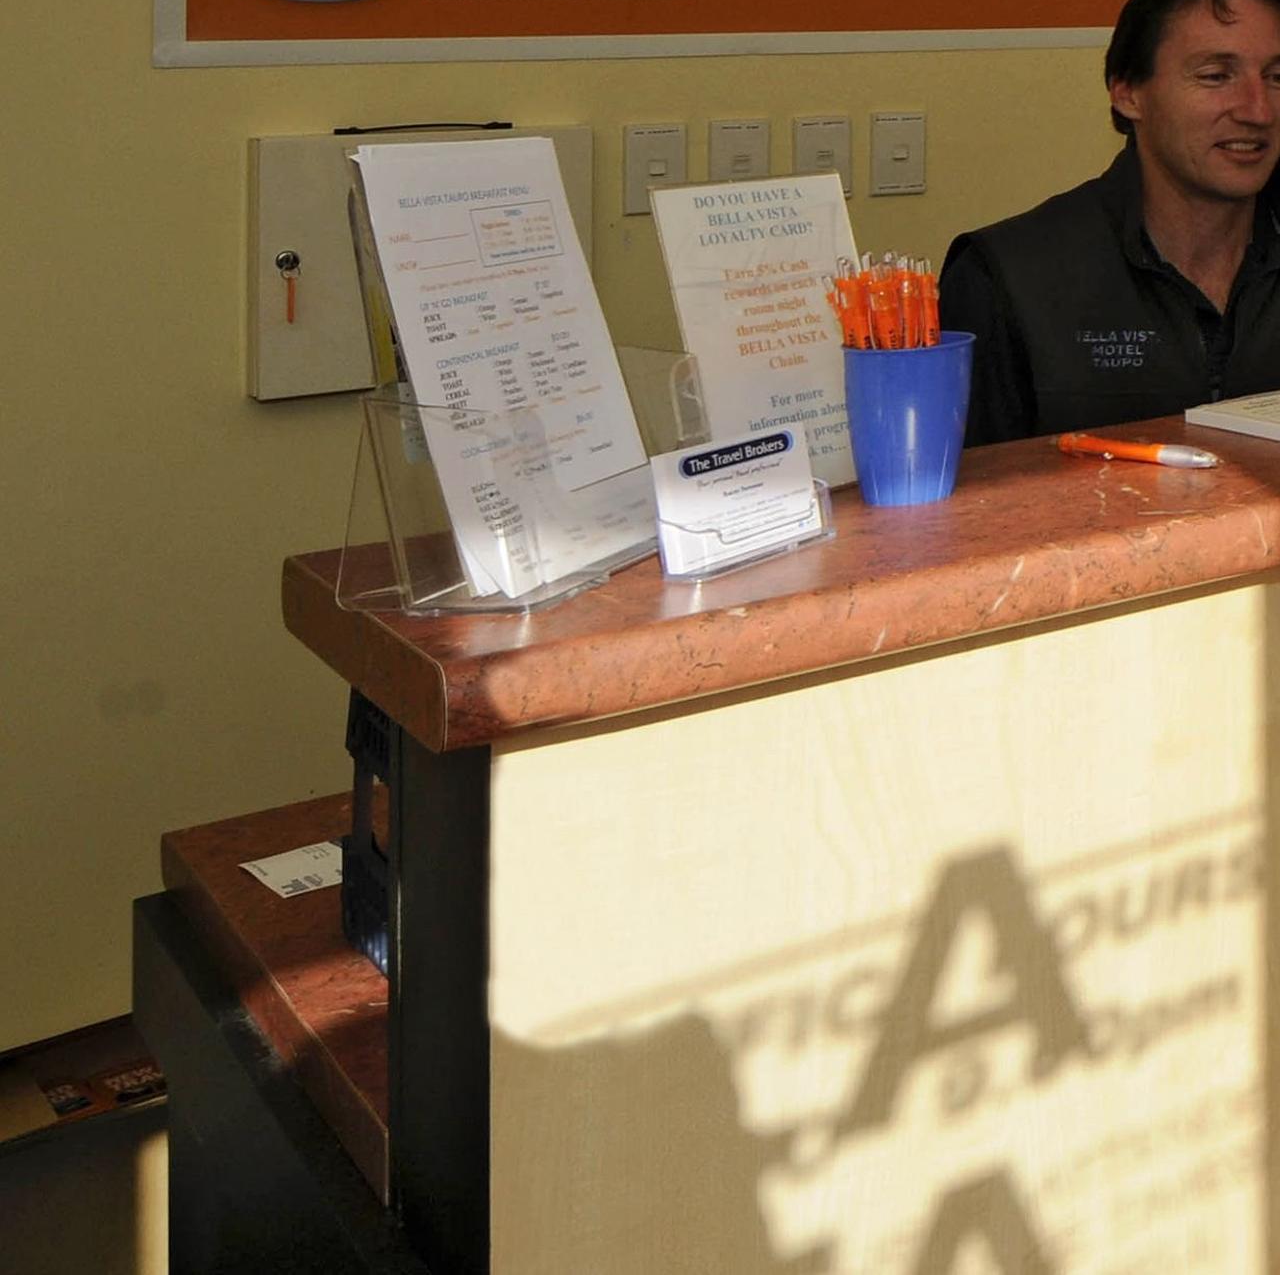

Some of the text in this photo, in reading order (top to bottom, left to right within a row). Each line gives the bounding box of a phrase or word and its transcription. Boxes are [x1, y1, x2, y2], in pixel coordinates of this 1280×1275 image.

[707, 205, 799, 227] BELLA VISTA
[699, 221, 814, 248] LOYALTY CARD?
[738, 330, 830, 359] BELLA VISTA
[749, 407, 818, 433] information
[688, 438, 786, 474] The Travel Brokers
